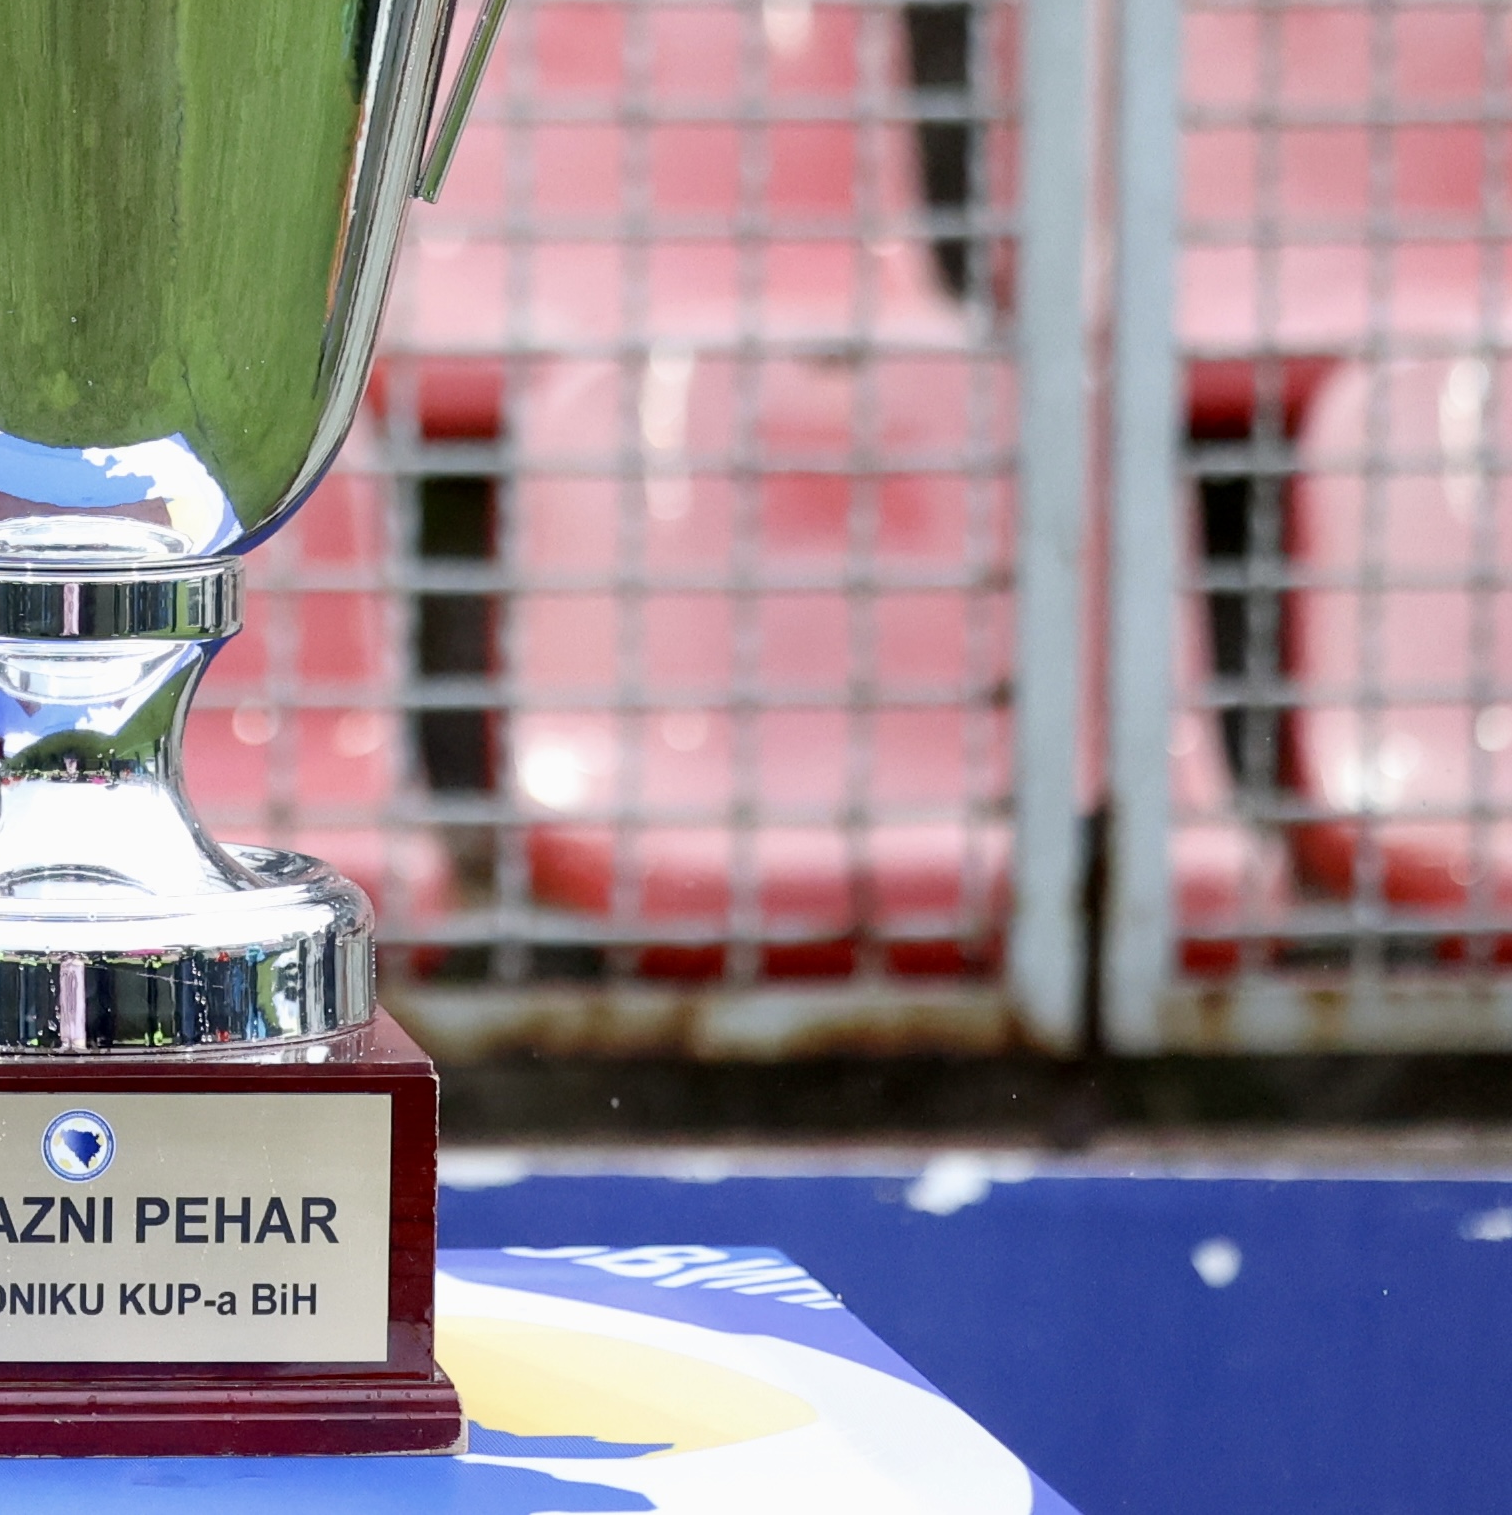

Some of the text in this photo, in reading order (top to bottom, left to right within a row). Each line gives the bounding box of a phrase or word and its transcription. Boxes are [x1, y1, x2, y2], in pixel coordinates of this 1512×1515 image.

[135, 1196, 339, 1244] PEHAR
[119, 1282, 237, 1317] KUP-a
[252, 1282, 317, 1317] BiH
